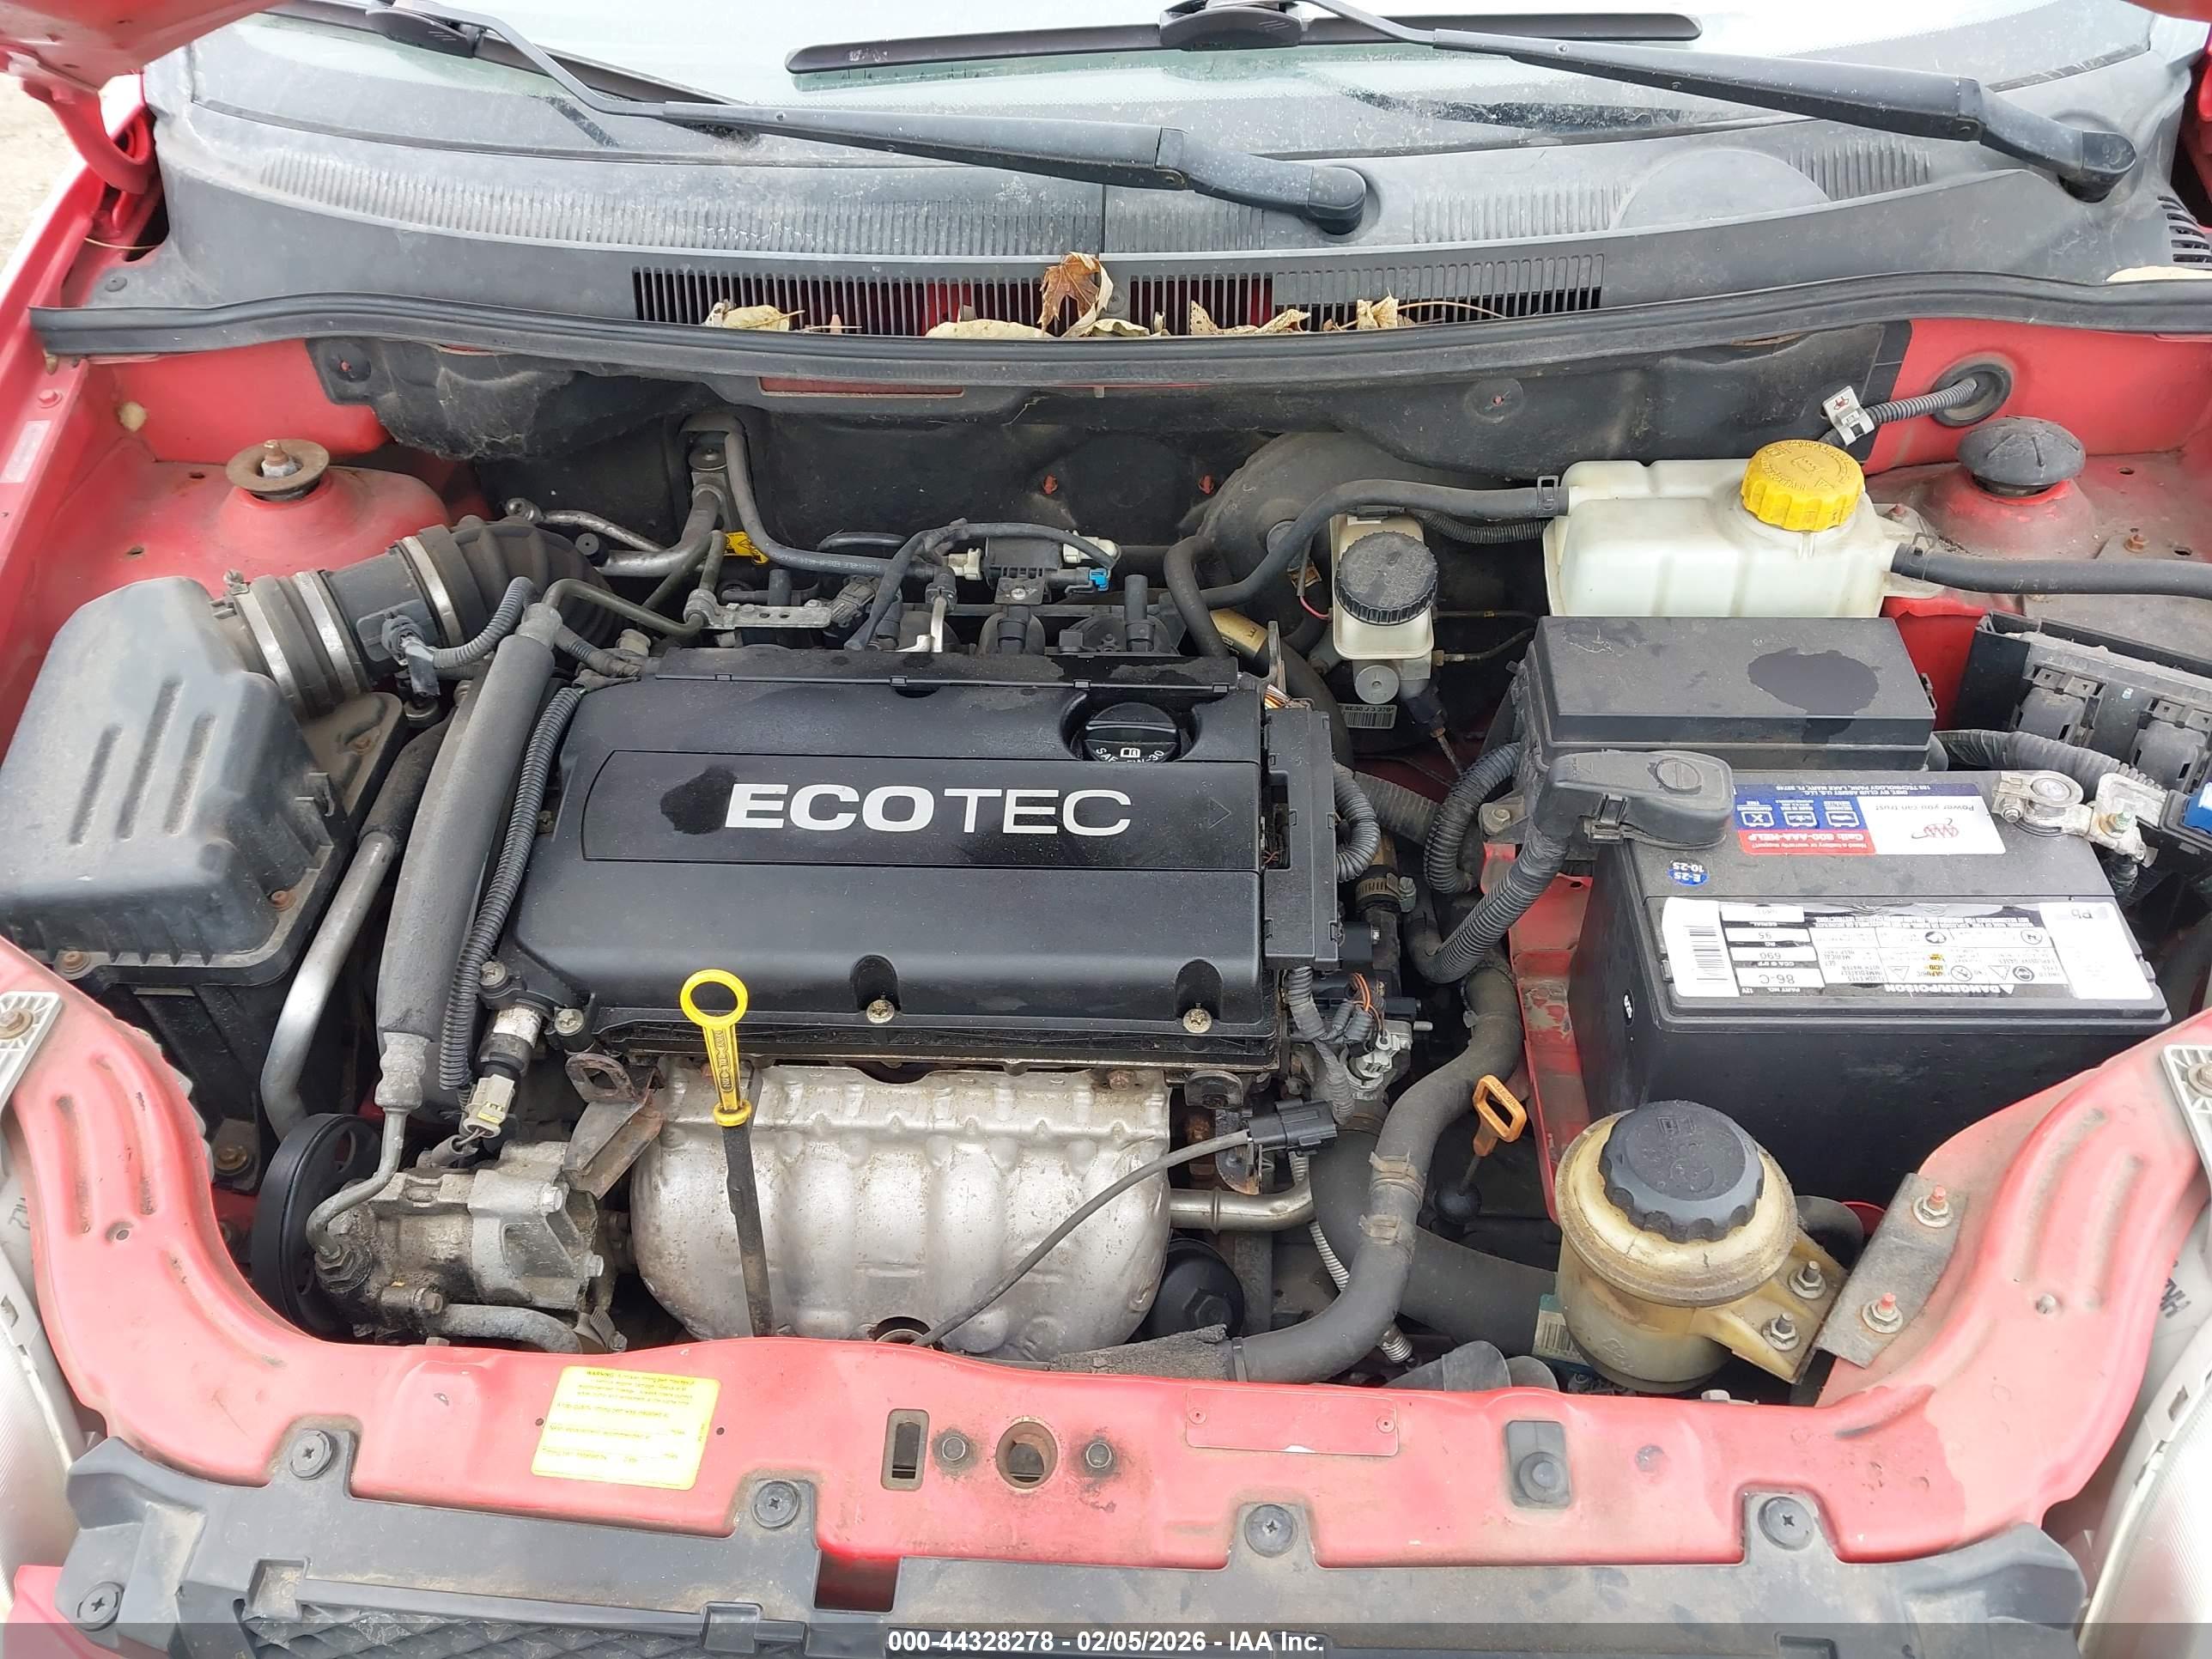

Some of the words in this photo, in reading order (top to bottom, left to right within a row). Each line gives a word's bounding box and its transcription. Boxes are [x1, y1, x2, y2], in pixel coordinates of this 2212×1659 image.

[725, 783, 1132, 836] ECOTEC
[1673, 862, 1704, 872] 10-25
[1674, 872, 1700, 883] E-25
[1759, 951, 1781, 960] 690
[1759, 974, 1795, 984] 86-C
